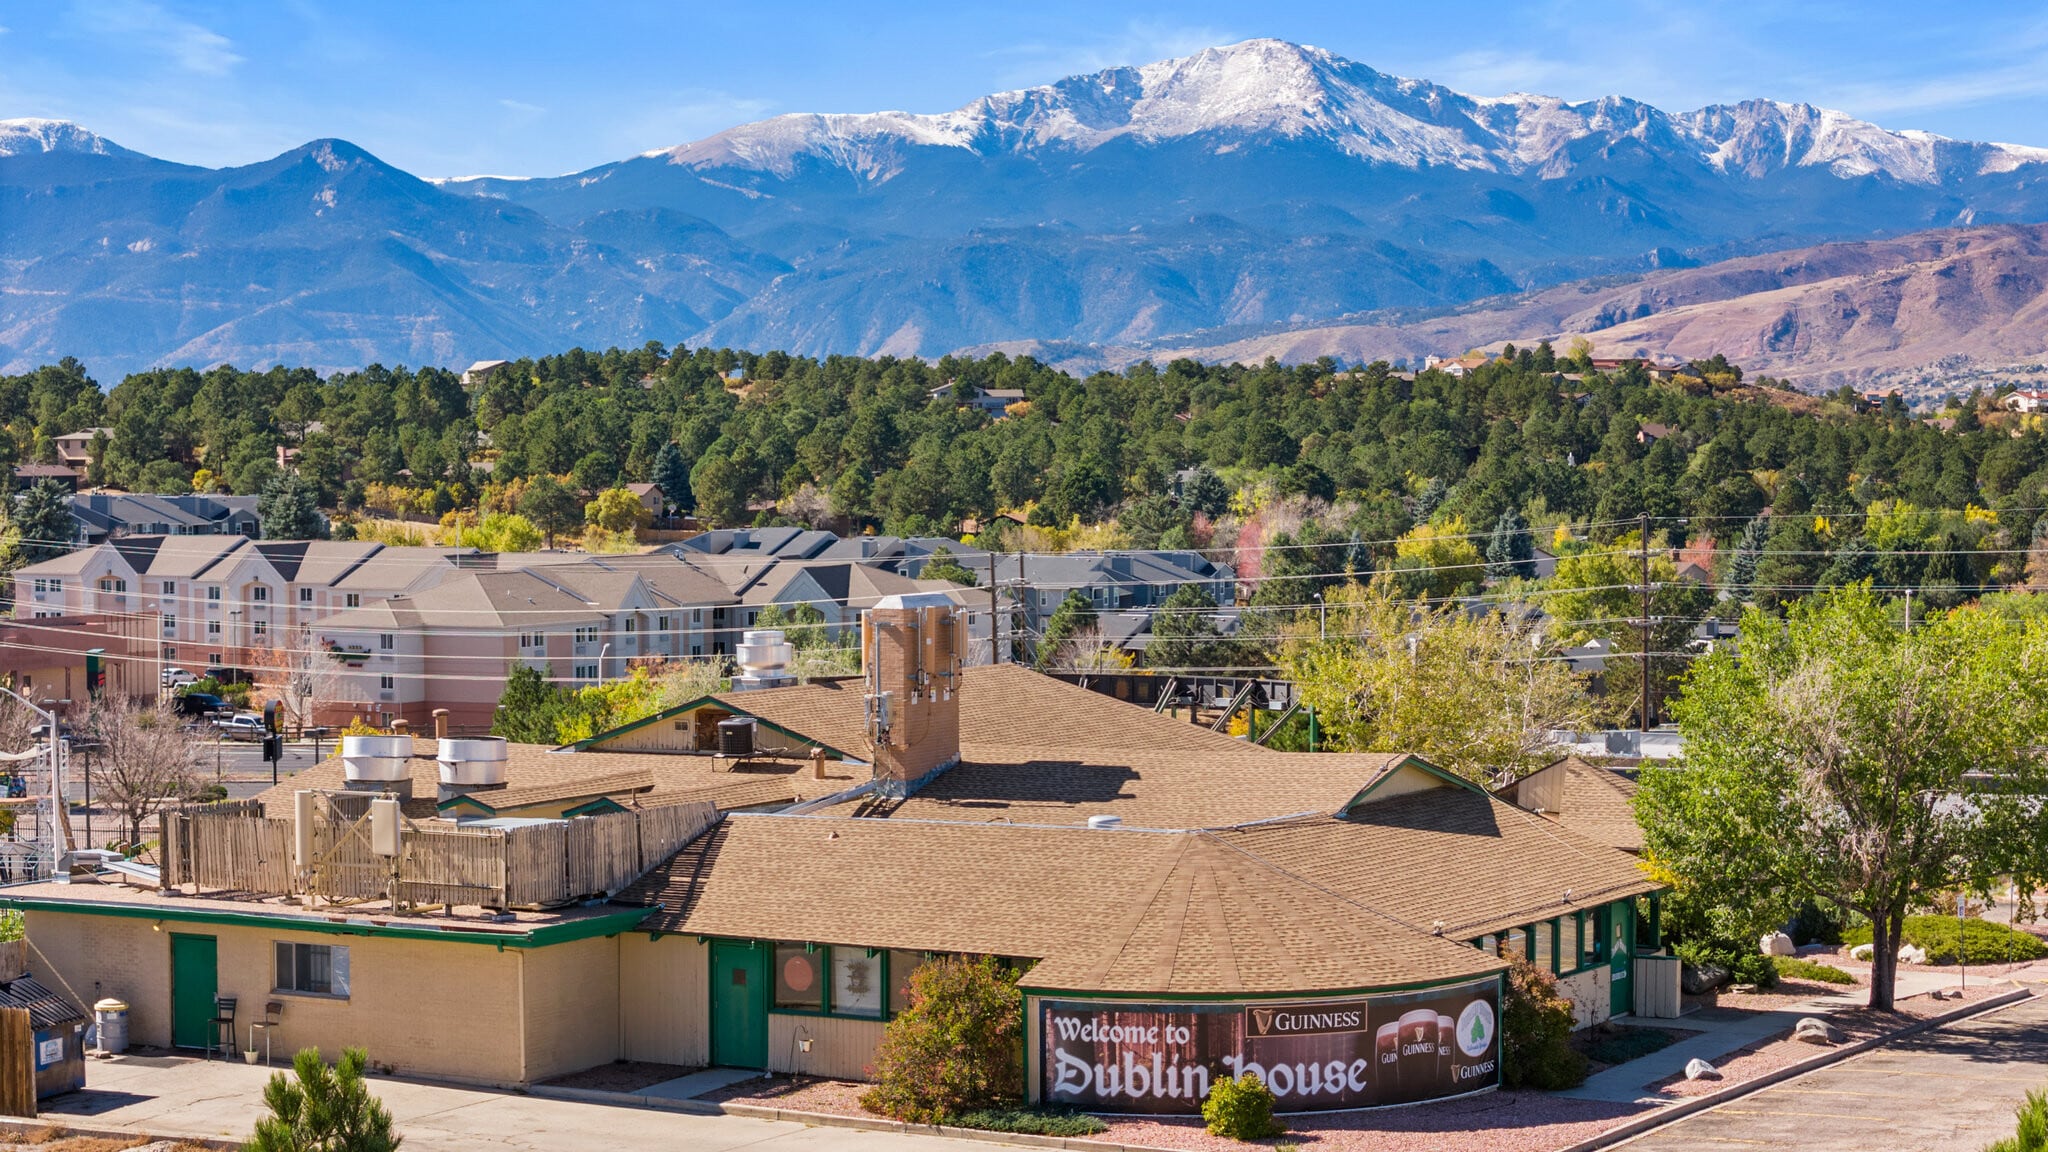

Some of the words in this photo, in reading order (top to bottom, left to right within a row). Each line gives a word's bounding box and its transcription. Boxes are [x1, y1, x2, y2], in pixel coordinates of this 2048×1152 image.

[1054, 1016, 1160, 1045] Welcome
[1165, 1023, 1190, 1045] to
[1275, 1011, 1360, 1031] GUINNESS
[1402, 1042, 1435, 1056] GUINNESS
[1054, 1047, 1213, 1098] Dublin
[1460, 1060, 1495, 1080] GUINNESS
